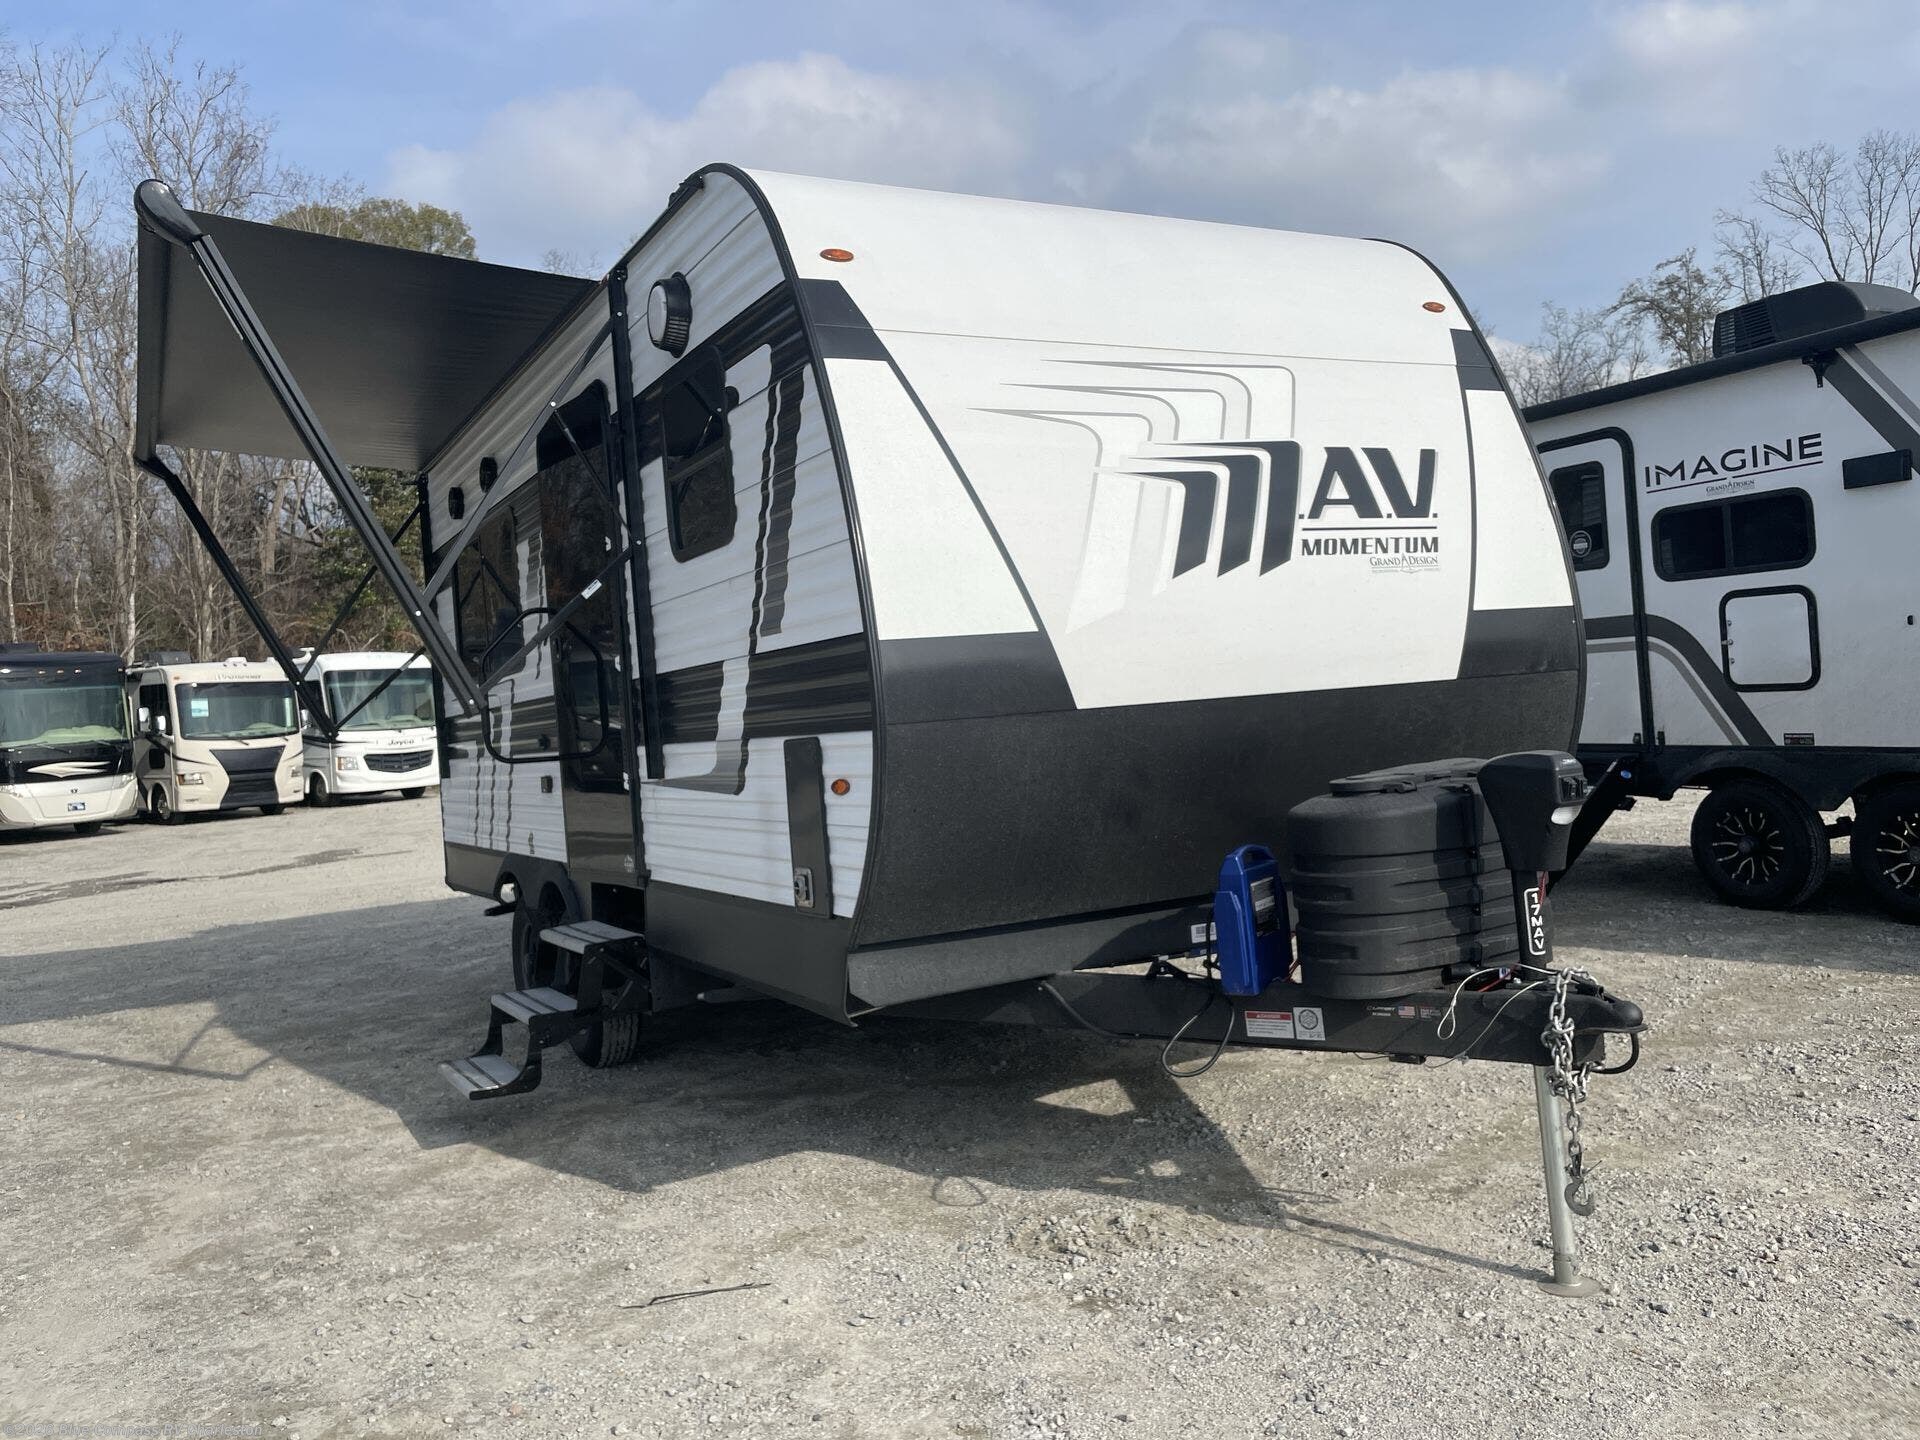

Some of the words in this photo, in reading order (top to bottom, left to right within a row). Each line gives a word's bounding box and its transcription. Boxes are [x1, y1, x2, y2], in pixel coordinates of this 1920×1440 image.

[1645, 433, 1823, 487] IMAGINE
[1706, 483, 1728, 492] GRAND
[1302, 537, 1439, 556] MOMENTUM
[1369, 556, 1401, 566] GRAND
[1408, 555, 1438, 565] DESIGN
[1530, 892, 1544, 950] 17MAV
